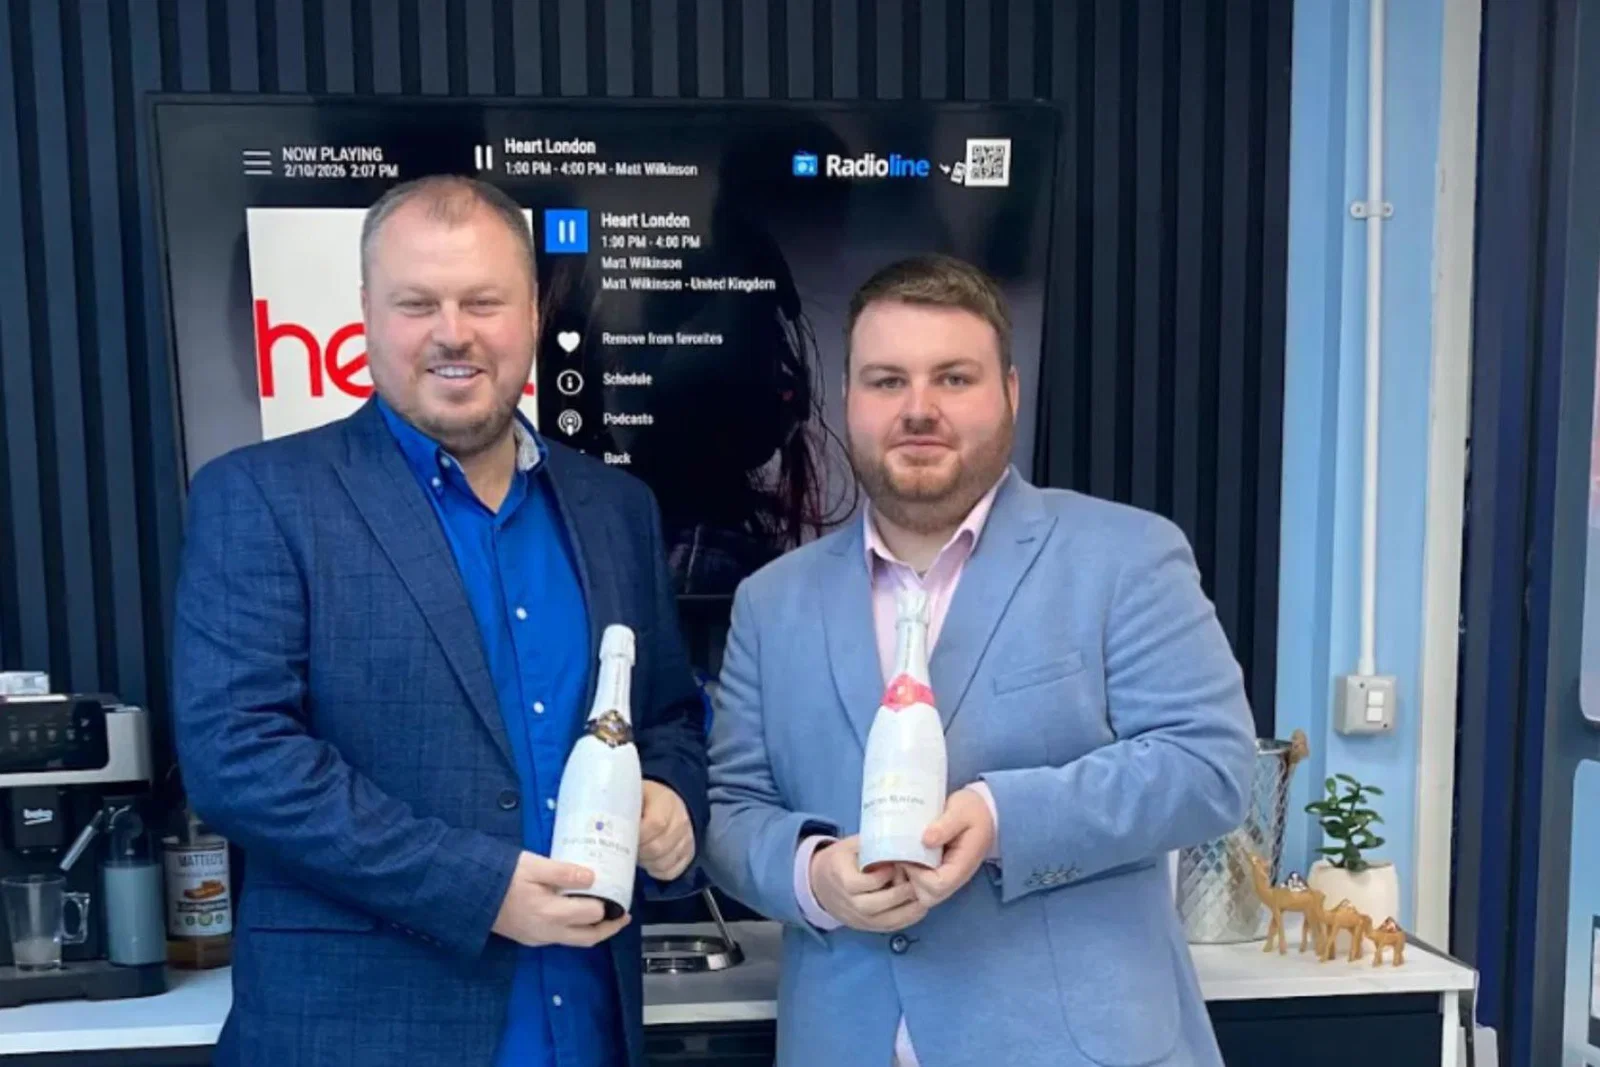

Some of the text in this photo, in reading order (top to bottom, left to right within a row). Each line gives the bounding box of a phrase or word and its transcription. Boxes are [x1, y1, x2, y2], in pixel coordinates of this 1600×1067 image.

[504, 137, 597, 154] Heart London
[282, 147, 383, 161] NOW PLAYING
[284, 163, 399, 177] 2/10/2026 2:07 PM
[505, 162, 530, 175] 1:00
[532, 162, 551, 175] PM
[560, 162, 586, 175] 4:00
[587, 162, 607, 175] PM
[615, 162, 642, 175] Matt
[644, 162, 698, 175] Wilkinson
[825, 152, 930, 178] Radioline
[601, 211, 690, 228] Heart London
[602, 235, 625, 248] 1:00
[627, 235, 647, 248] PM
[655, 235, 679, 248] 4:00
[681, 235, 701, 248] PM
[602, 256, 682, 269] Matt Wilkinson
[602, 277, 627, 290] Matt
[629, 277, 682, 290] Wilkinson
[690, 277, 726, 290] United
[728, 277, 776, 293] Kingdom
[602, 332, 723, 345] Remove from favorites
[603, 372, 653, 385] Schedule
[603, 412, 654, 425] Podcasts
[604, 452, 631, 464] Back
